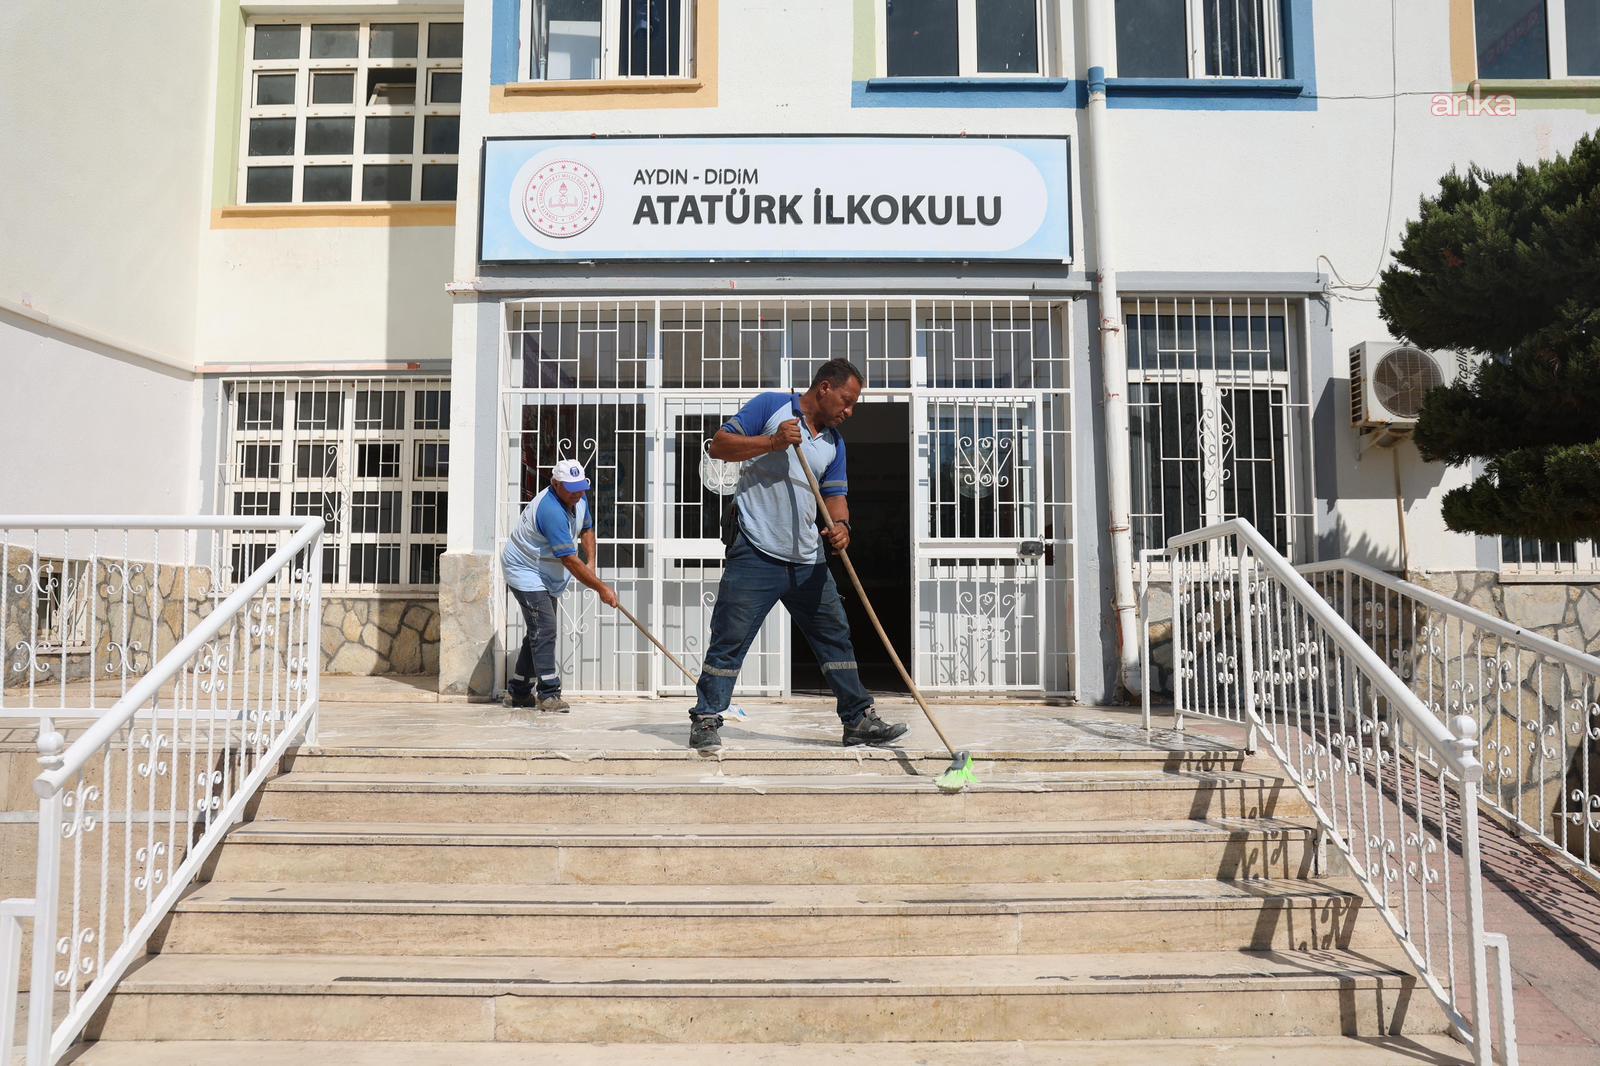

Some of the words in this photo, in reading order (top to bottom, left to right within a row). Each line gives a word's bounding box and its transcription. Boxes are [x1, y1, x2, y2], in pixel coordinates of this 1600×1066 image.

[633, 168, 688, 185] AYDIN
[632, 187, 804, 225] ATATÜRK
[813, 187, 1002, 226] İLKOKULU
